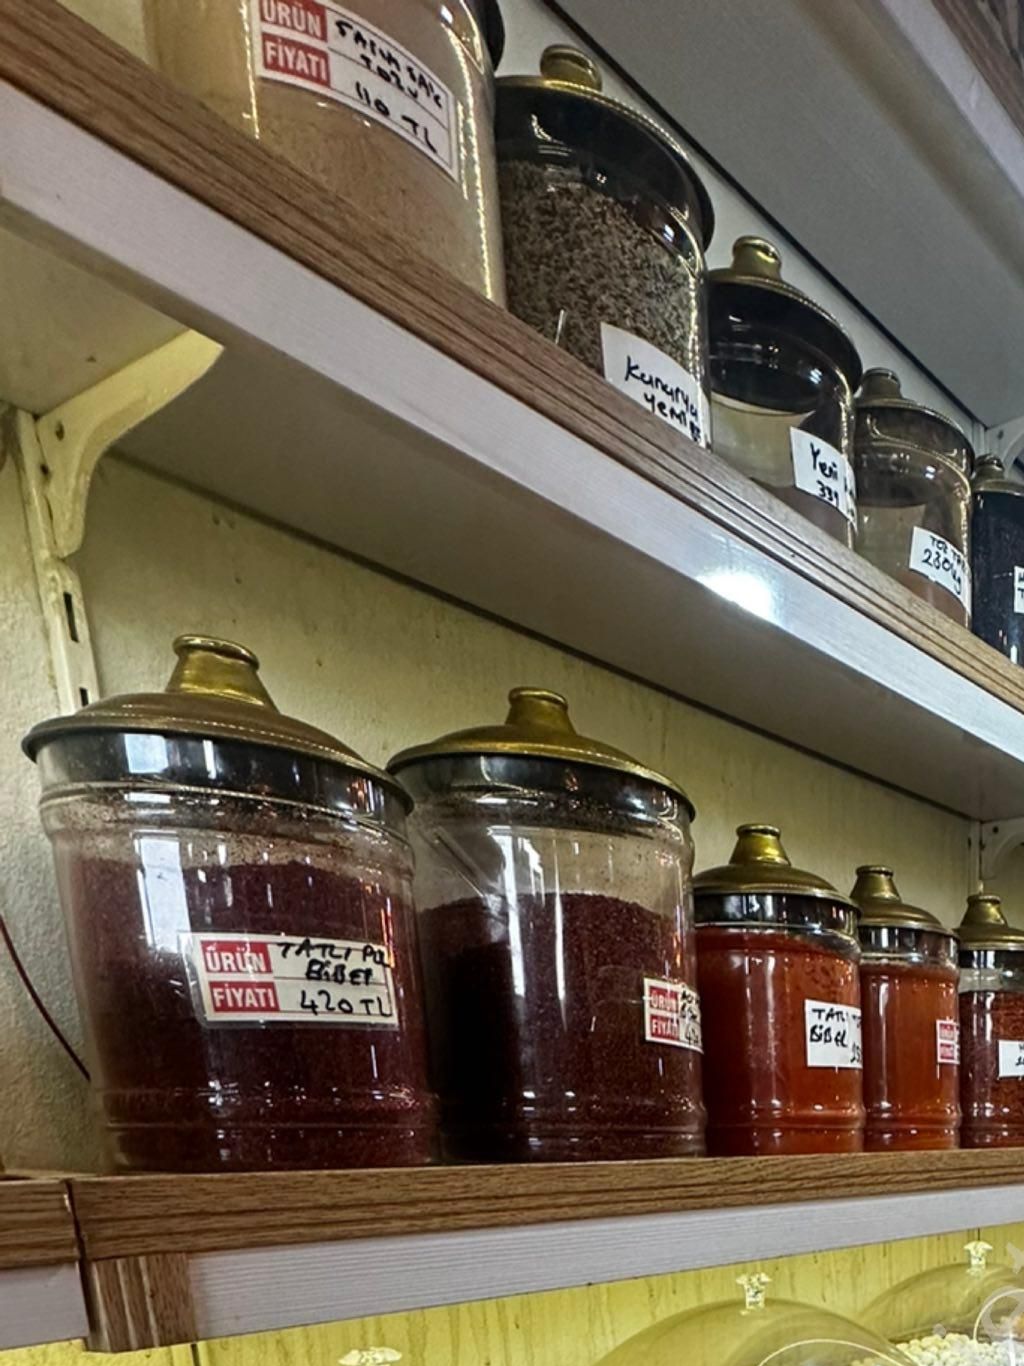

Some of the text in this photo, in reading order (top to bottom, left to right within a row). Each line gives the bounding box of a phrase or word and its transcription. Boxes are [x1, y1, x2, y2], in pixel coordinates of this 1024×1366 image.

[265, 39, 328, 83] FİYATI
[206, 942, 266, 973] ÜRÜN
[213, 981, 277, 1008] FİYATI
